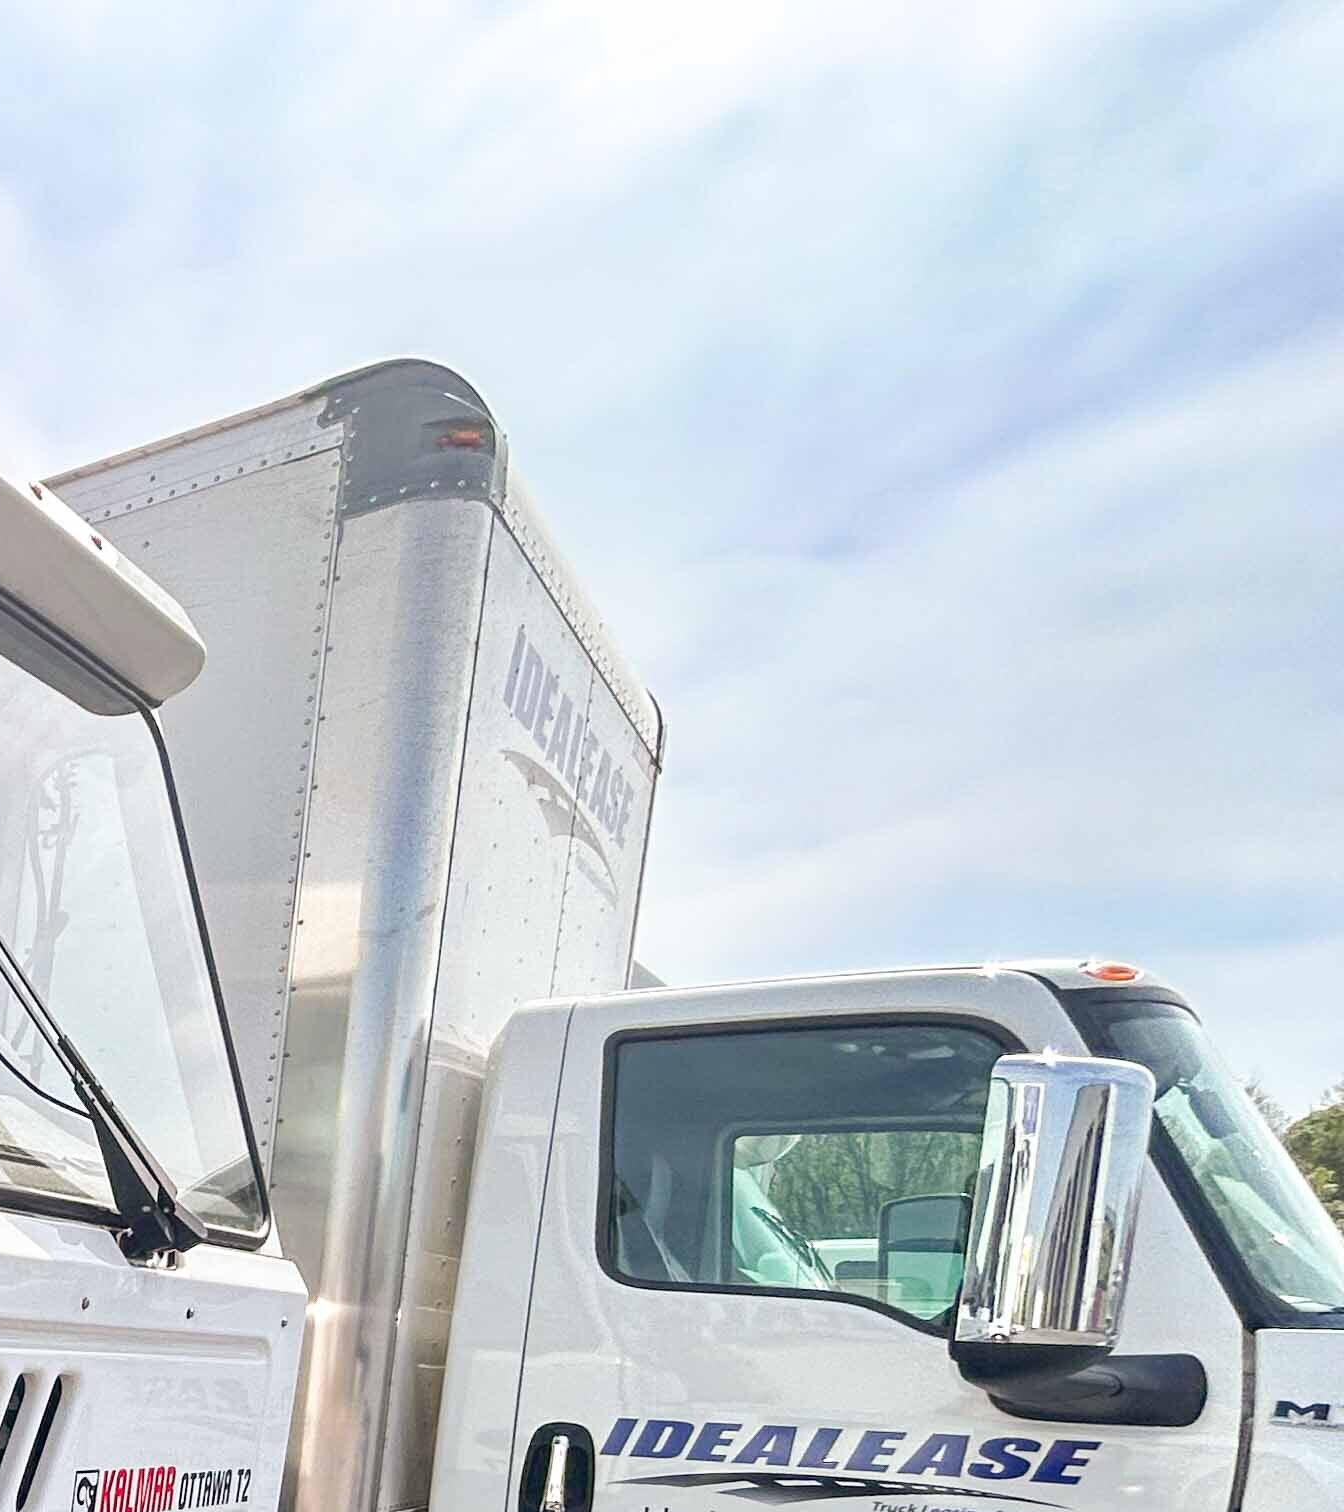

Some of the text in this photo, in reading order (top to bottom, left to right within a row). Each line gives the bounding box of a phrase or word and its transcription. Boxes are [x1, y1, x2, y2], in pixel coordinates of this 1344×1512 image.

[503, 624, 635, 850] IDEALEASE
[1273, 1400, 1331, 1421] M
[600, 1418, 1104, 1485] IDEALEASE
[178, 1470, 232, 1510] OTTAWA
[234, 1468, 252, 1503] T2
